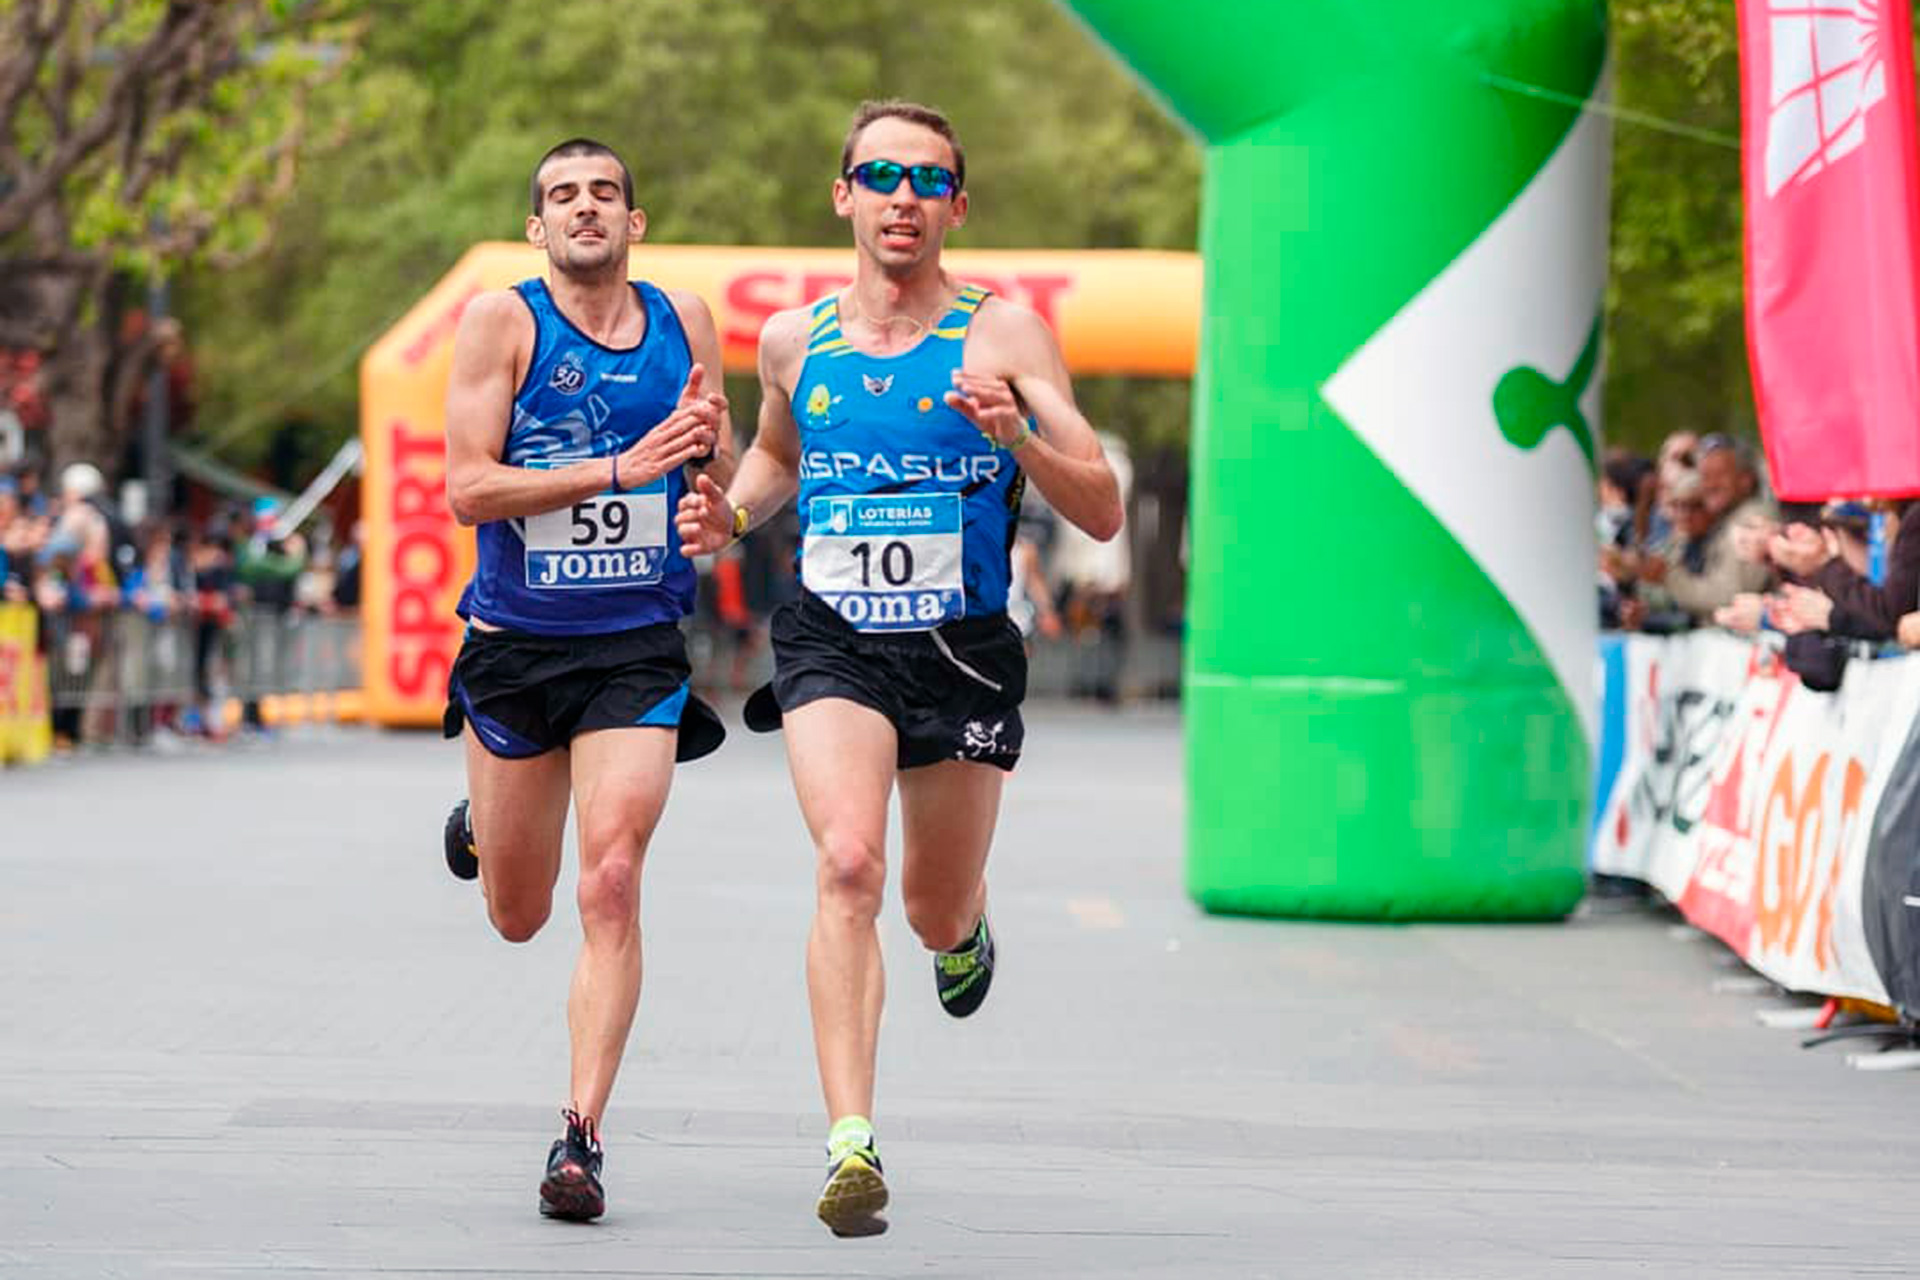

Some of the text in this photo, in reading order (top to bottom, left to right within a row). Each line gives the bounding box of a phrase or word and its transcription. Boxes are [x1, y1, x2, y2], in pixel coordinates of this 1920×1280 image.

[571, 501, 630, 546] 59
[858, 504, 932, 519] LOTERÍAS
[391, 424, 456, 699] SPORT
[850, 541, 914, 588] 10
